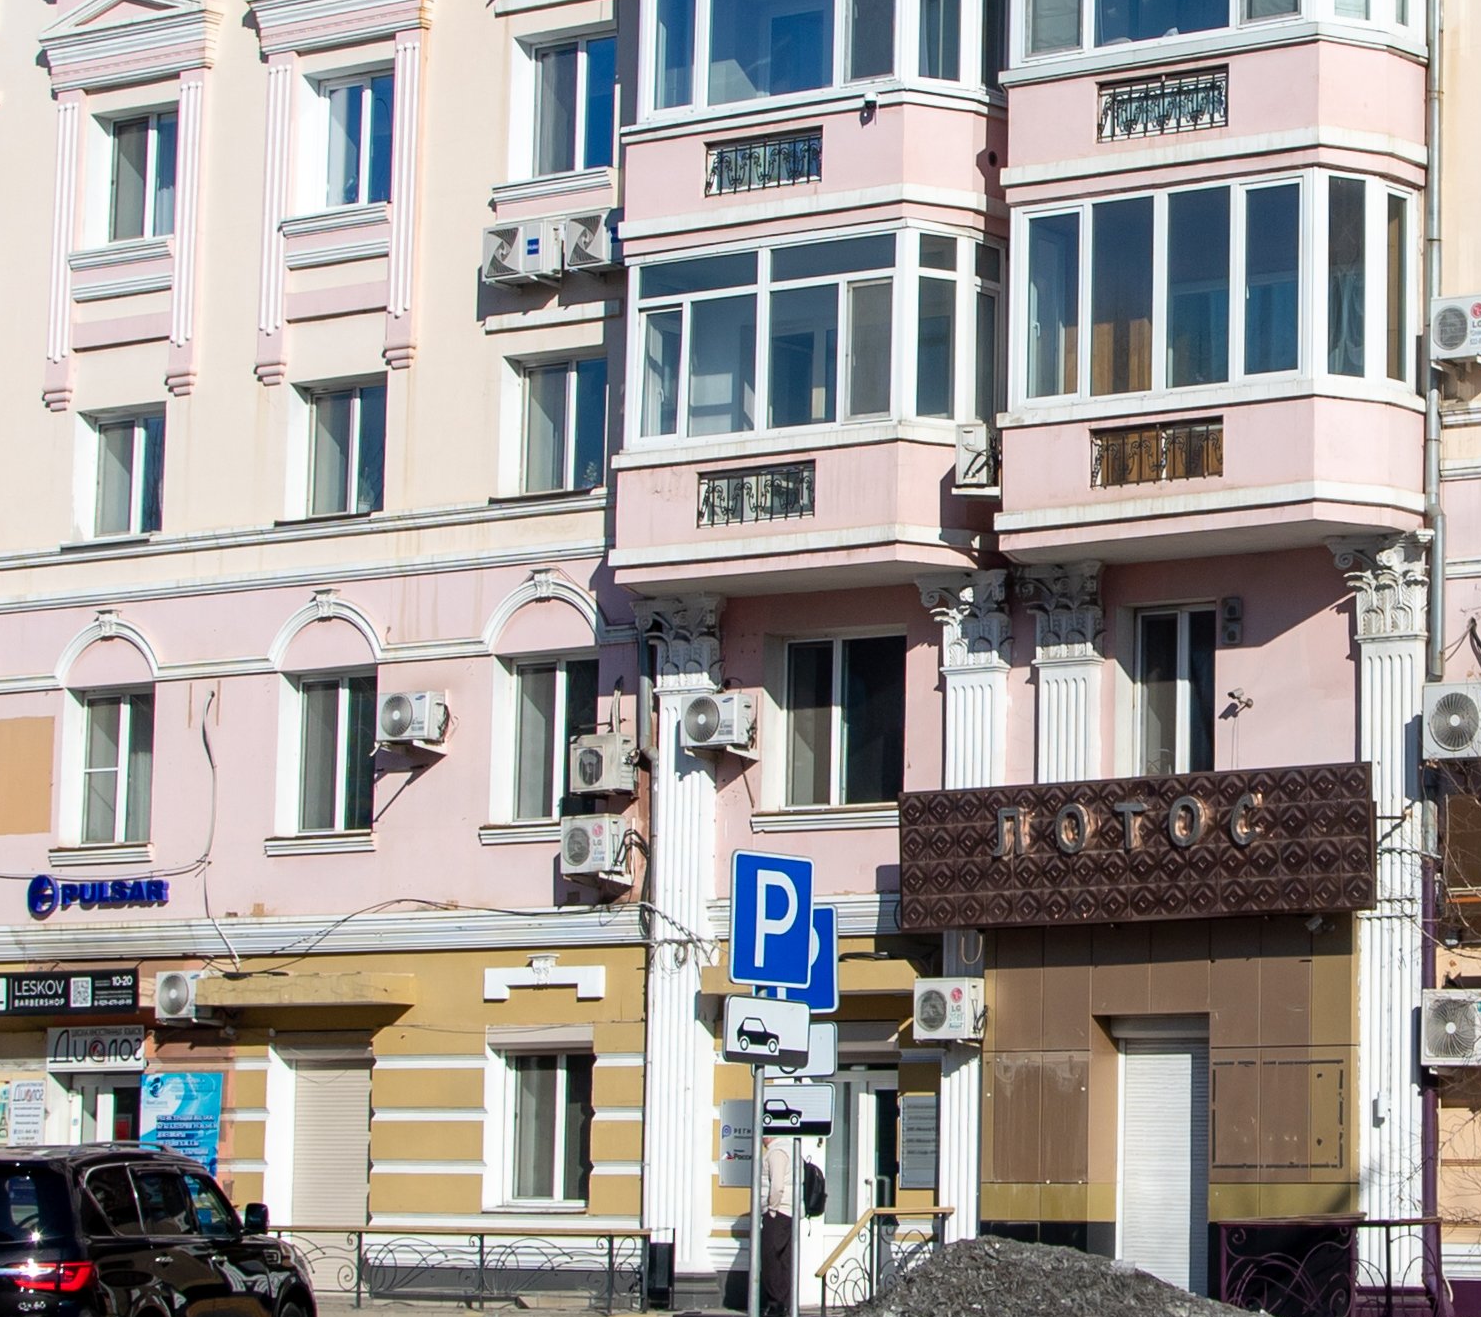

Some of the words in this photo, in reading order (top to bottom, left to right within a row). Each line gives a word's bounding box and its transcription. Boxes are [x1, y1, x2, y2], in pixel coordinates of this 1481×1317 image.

[993, 793, 1265, 858] ЛОТОС
[60, 880, 169, 906] PULSAR
[754, 869, 799, 968] P
[14, 980, 65, 996] LESKOV
[14, 998, 65, 1008] BARBERSHOP
